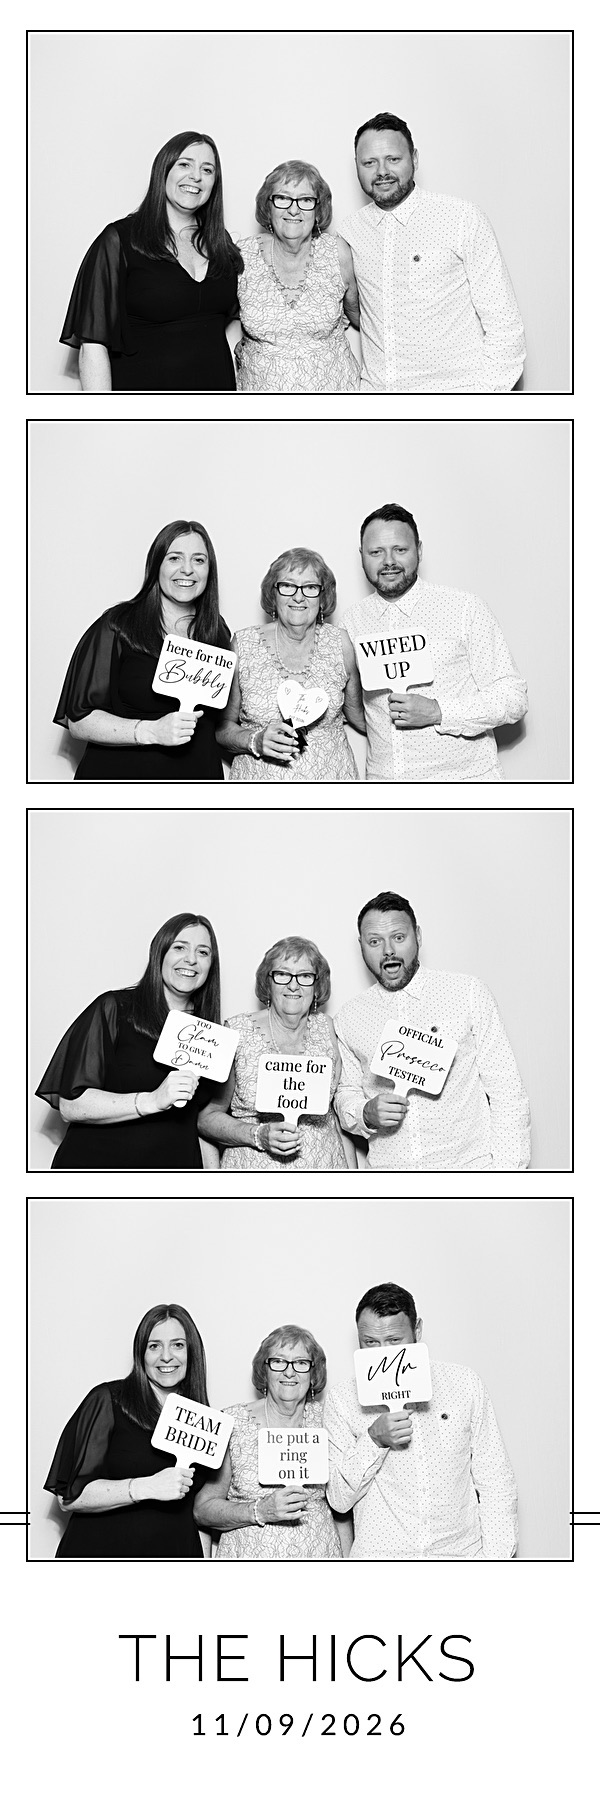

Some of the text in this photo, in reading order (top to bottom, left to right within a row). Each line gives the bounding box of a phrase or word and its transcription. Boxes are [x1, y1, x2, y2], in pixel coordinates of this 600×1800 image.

[166, 640, 233, 670] here for the
[359, 634, 426, 658] WIFED
[159, 659, 227, 699] Bubbly
[383, 661, 410, 680] UP
[196, 1020, 212, 1030] TOO
[398, 1026, 444, 1049] OFFICIAL
[178, 1042, 189, 1050] TO
[189, 1046, 207, 1057] GIVE
[381, 1040, 446, 1072] Prosecco
[265, 1060, 327, 1074] came for
[388, 1065, 426, 1087] TESTER
[283, 1077, 305, 1091] the
[277, 1095, 308, 1109] food
[367, 1348, 417, 1387] Mr
[381, 1390, 411, 1401] RIGHT
[175, 1406, 222, 1436] TEAM
[164, 1425, 218, 1457] BRIDE
[267, 1431, 320, 1446] he put a
[280, 1448, 308, 1464] ring
[278, 1466, 309, 1479] on it
